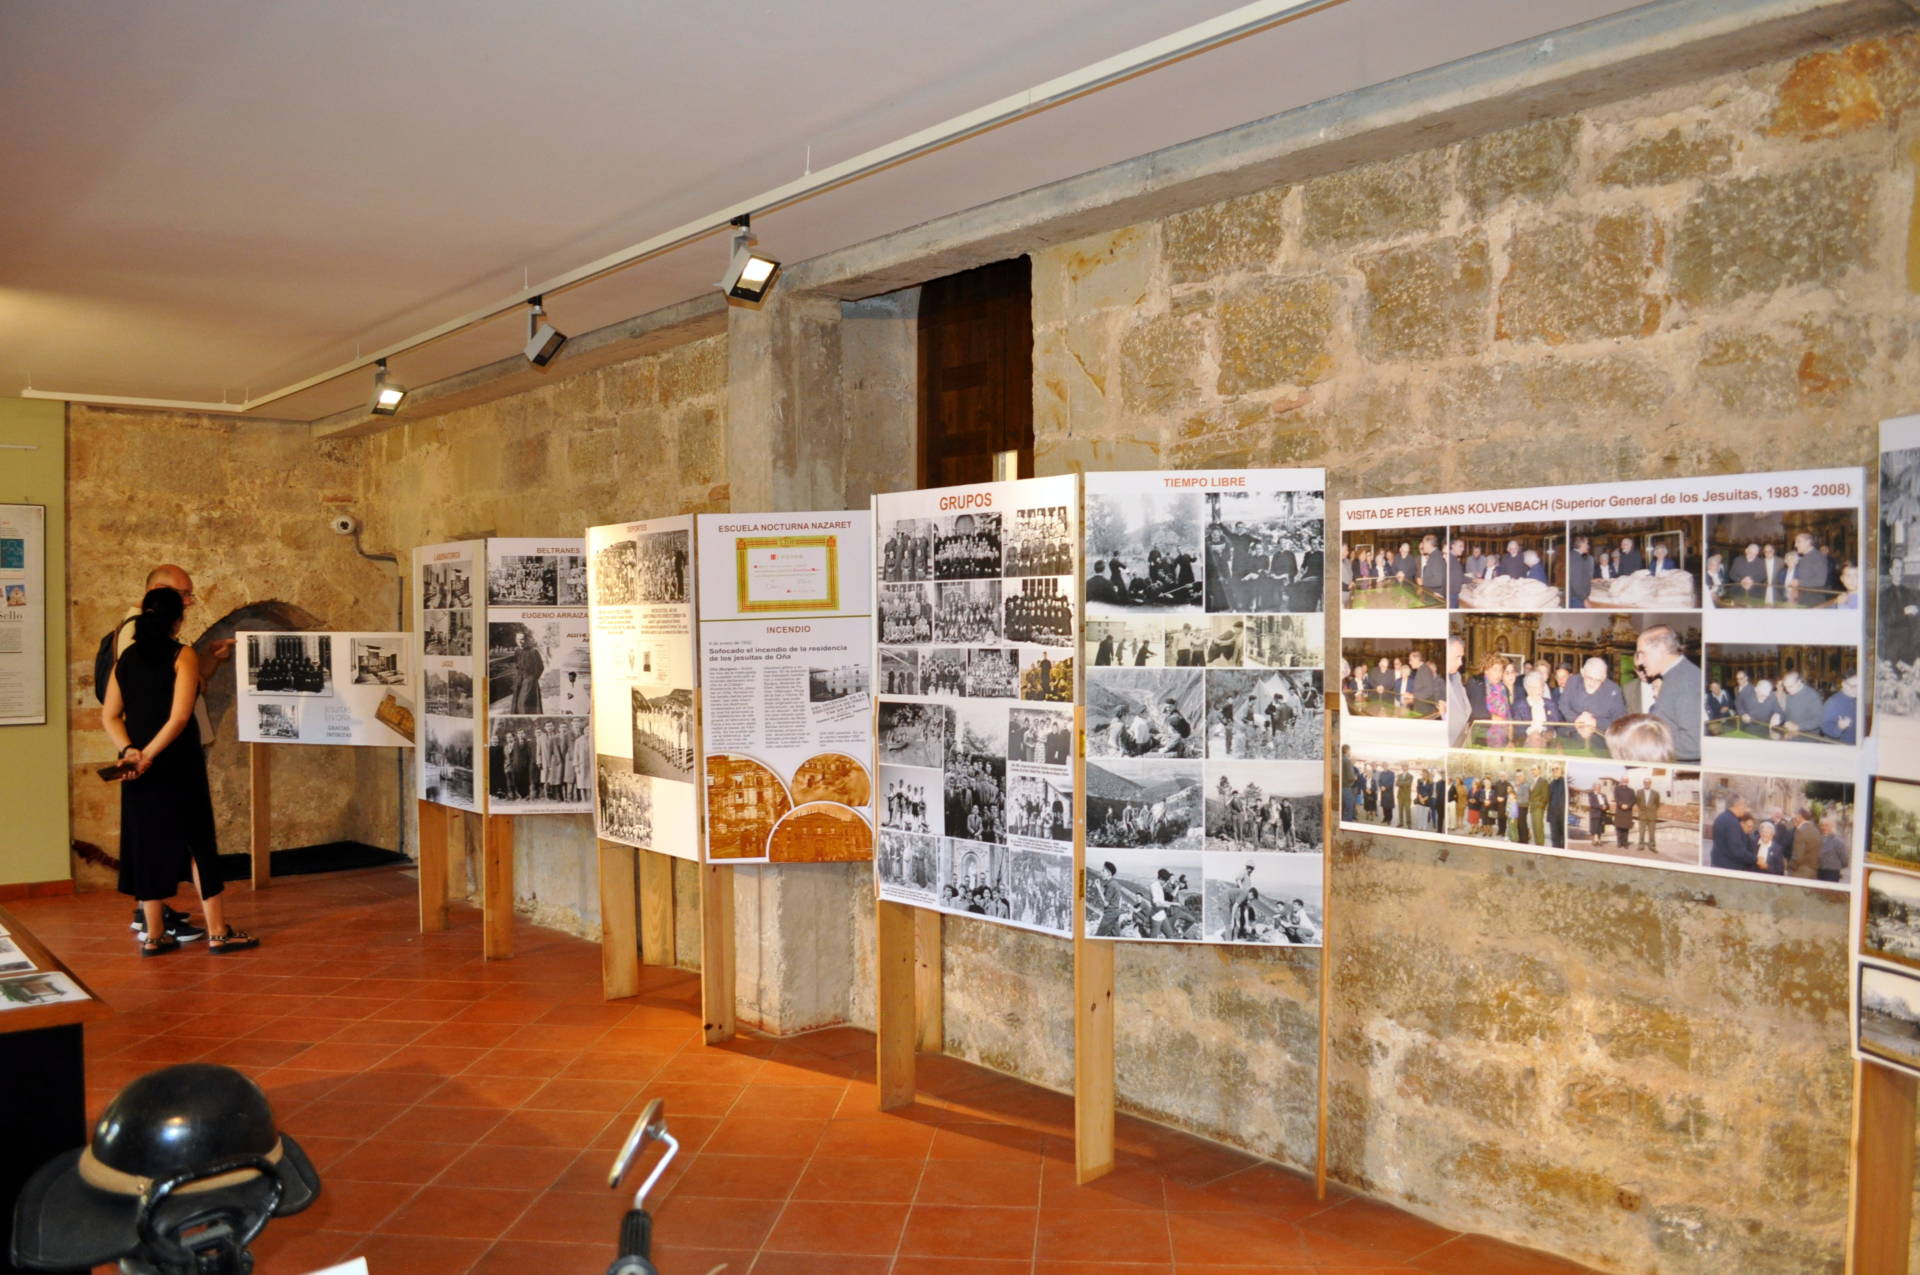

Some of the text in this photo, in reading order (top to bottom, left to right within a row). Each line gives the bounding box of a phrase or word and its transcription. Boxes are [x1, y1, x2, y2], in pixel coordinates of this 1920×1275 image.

[1164, 476, 1246, 488] TIEMPO LIBRE
[940, 492, 992, 510] GRUPOS
[1346, 509, 1378, 521] VISITA
[1380, 508, 1394, 518] DE
[1396, 506, 1431, 518] PETER
[1434, 504, 1465, 516] HANS
[1468, 500, 1548, 514] KOLVENBACH
[1551, 497, 1606, 512] (Superior
[1609, 494, 1657, 508] General
[1660, 492, 1676, 504] de
[1680, 492, 1698, 504] los
[1702, 488, 1762, 502] Jesuitas,
[1766, 486, 1800, 499] 1983
[1812, 483, 1851, 498] 2008)
[718, 520, 852, 533] ESCUELA NOCTURNA NAZARET
[766, 626, 812, 634] INCENDIO
[734, 654, 762, 662] jesuitas
